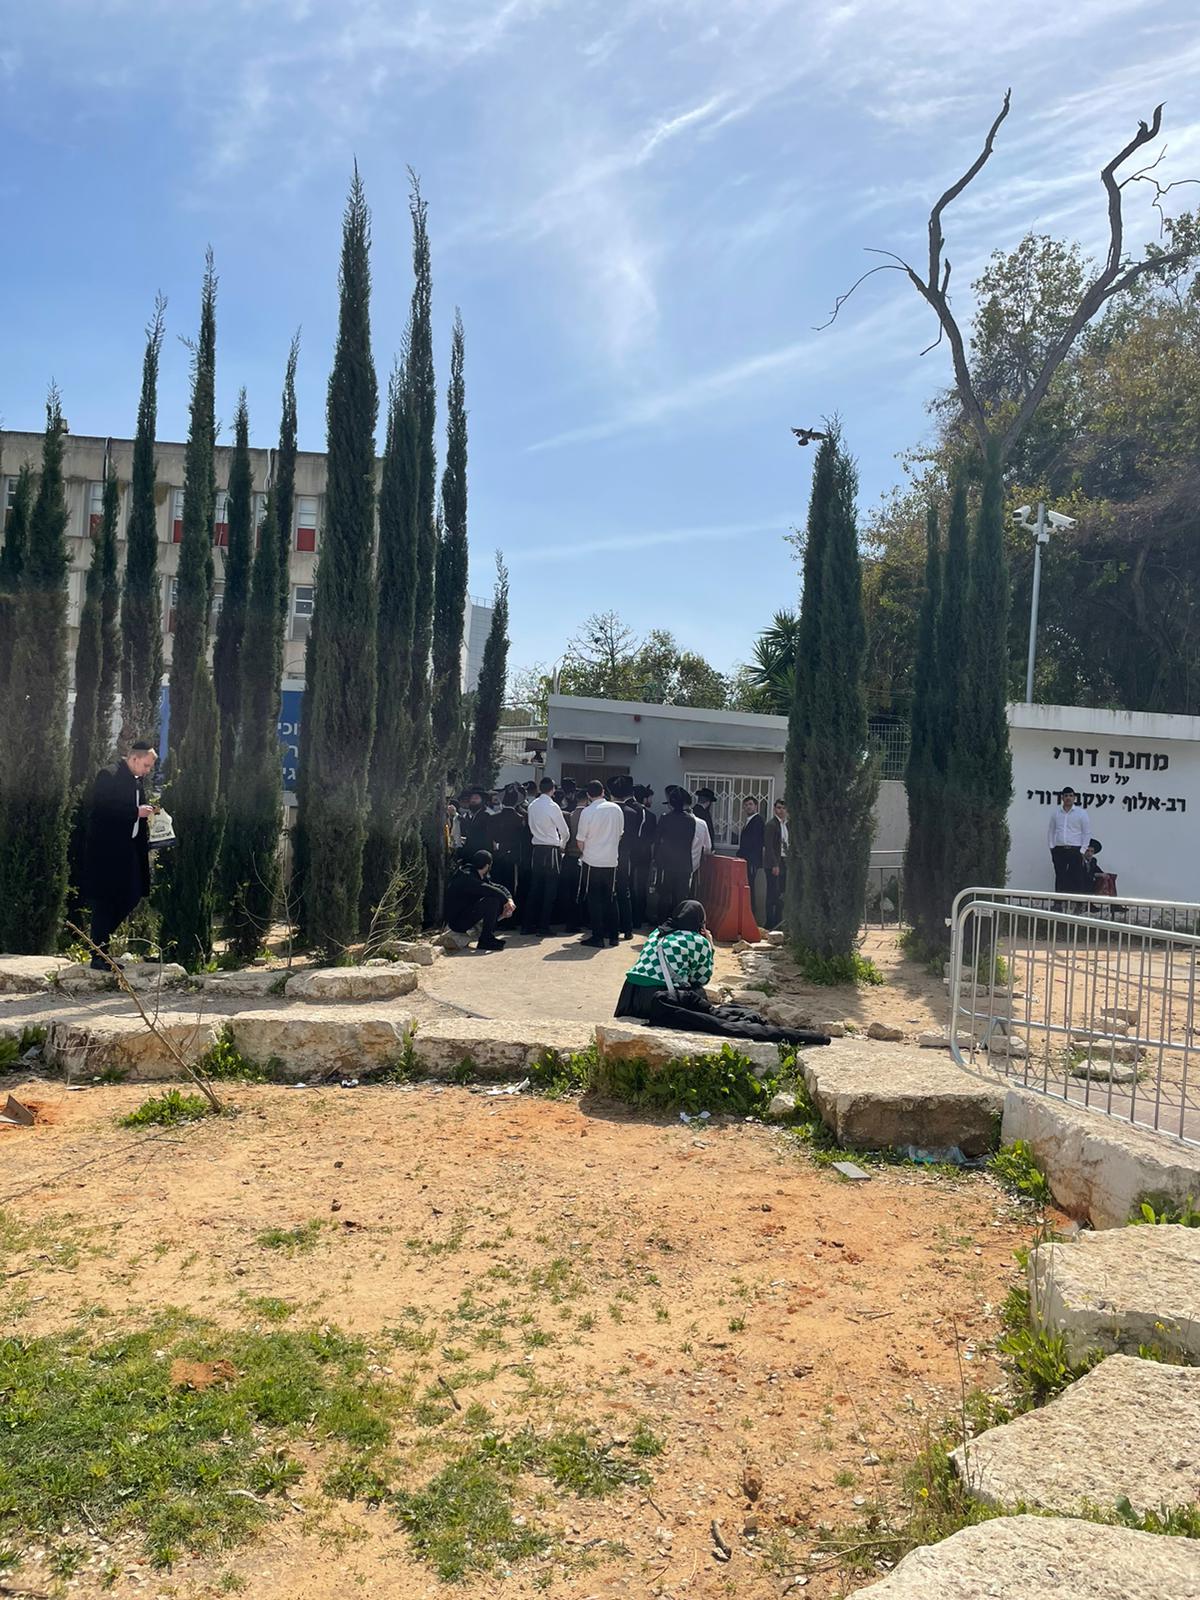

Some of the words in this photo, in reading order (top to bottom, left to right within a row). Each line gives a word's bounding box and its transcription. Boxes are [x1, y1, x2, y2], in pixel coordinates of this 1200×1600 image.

[1053, 747, 1099, 766] דורי
[1109, 750, 1169, 770] מחנה
[1090, 774, 1110, 784] שם
[1115, 773, 1130, 785] על
[1027, 790, 1064, 805] דורי
[1074, 792, 1115, 809] יעקב
[1122, 792, 1187, 812] רב-אלוף
